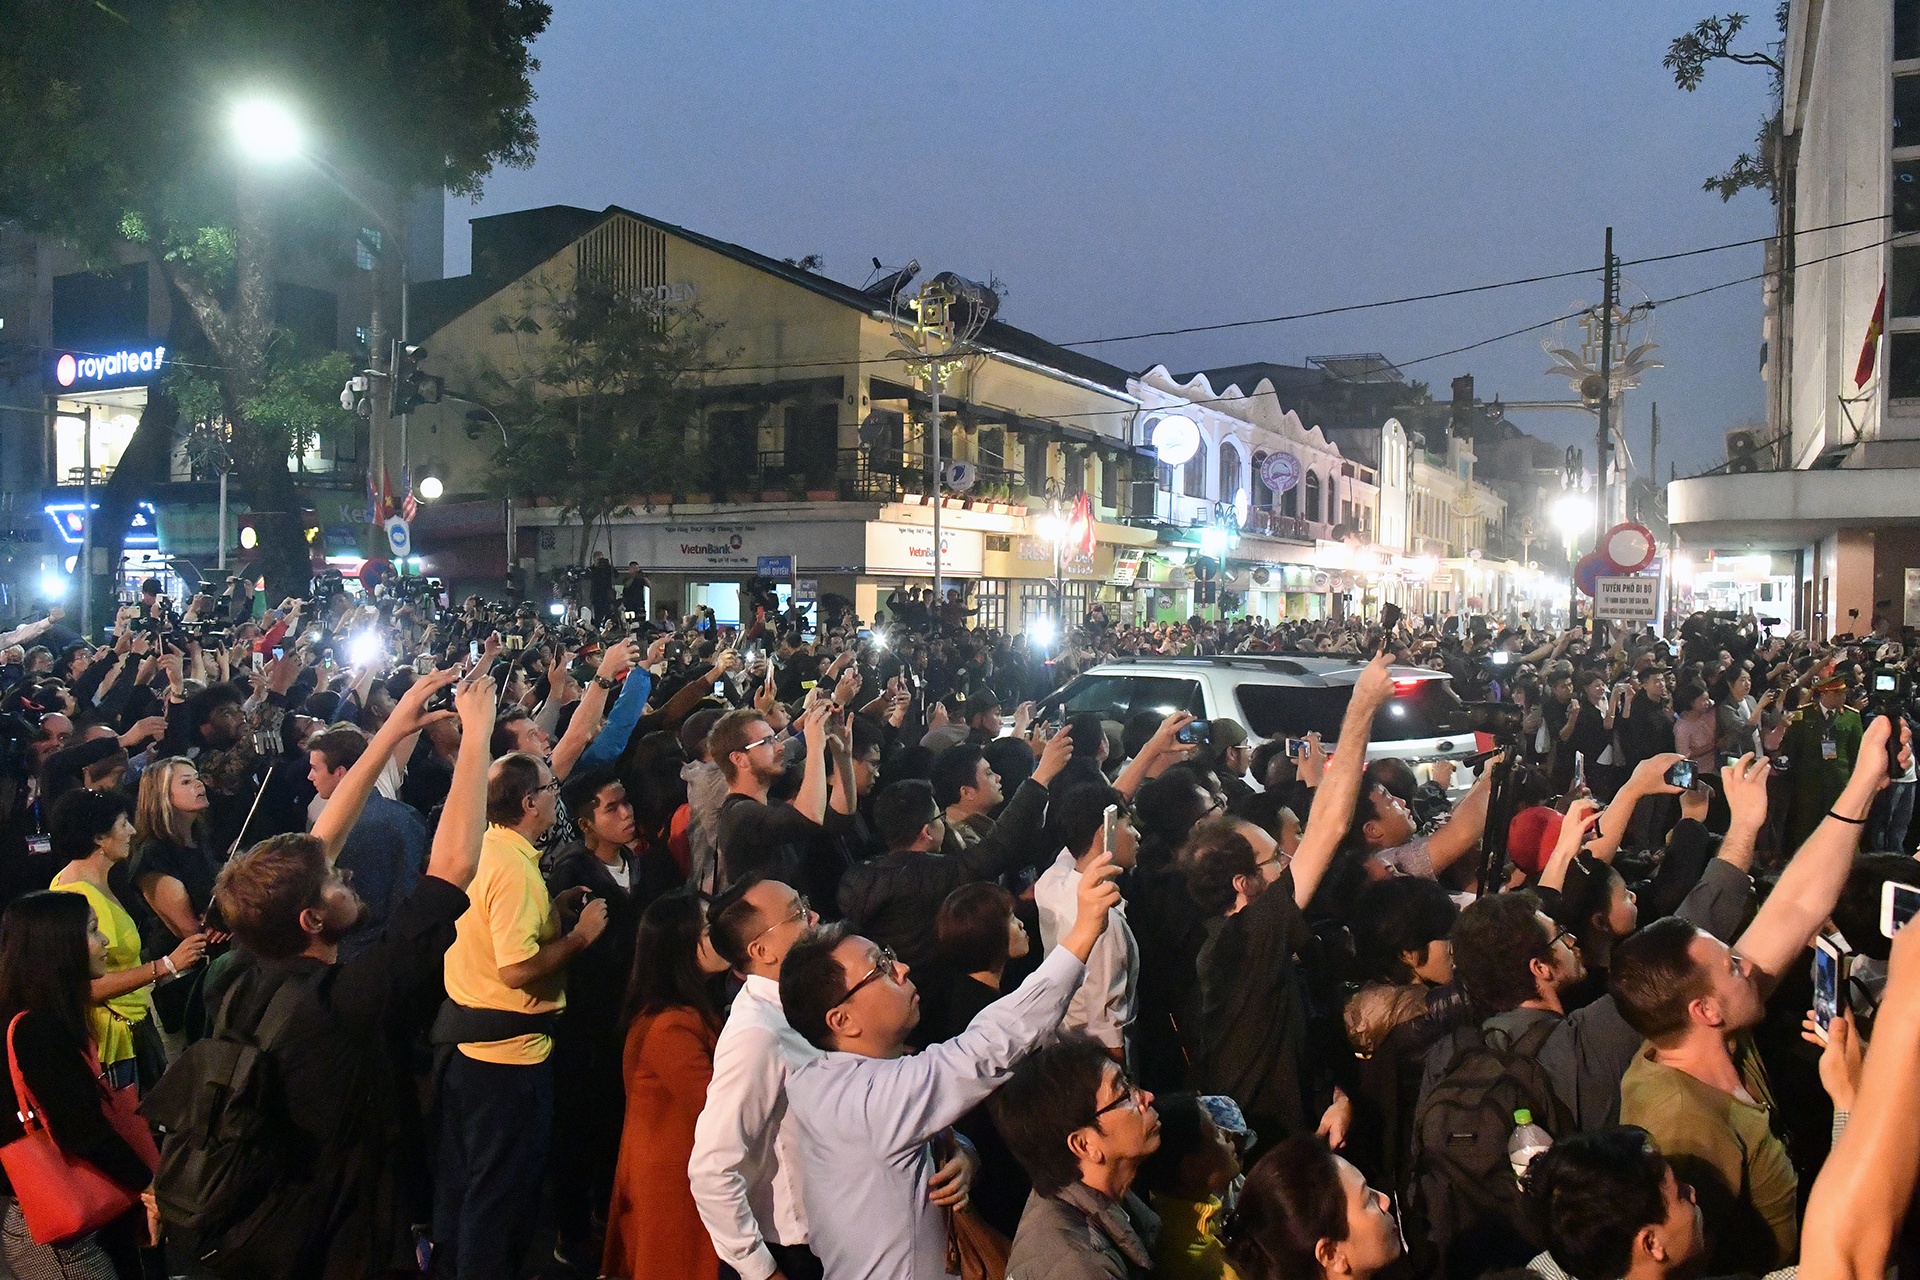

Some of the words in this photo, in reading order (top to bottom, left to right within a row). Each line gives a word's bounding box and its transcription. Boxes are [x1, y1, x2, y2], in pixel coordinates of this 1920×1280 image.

[78, 350, 153, 380] royaltea
[681, 543, 731, 554] VietinBank
[909, 546, 936, 557] VietinBa
[1602, 582, 1621, 593] TUYẾN
[1622, 581, 1635, 593] PHỐ
